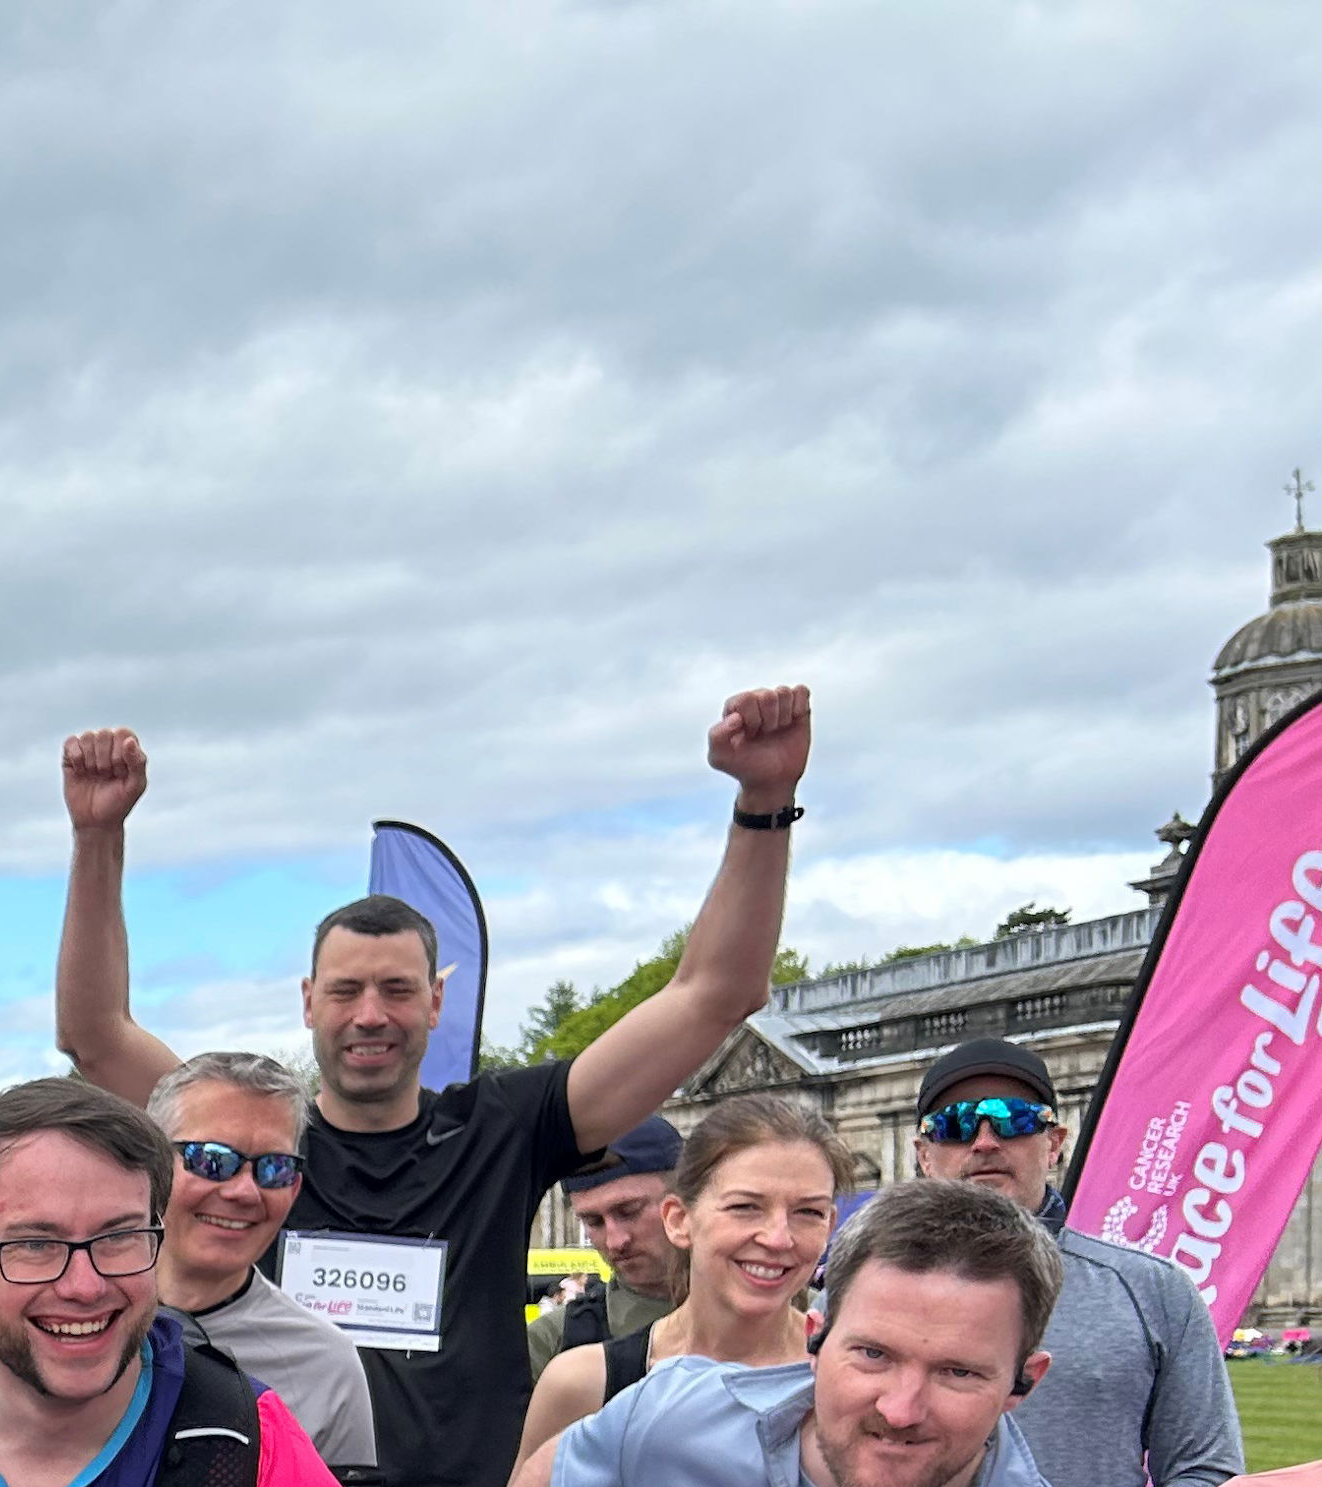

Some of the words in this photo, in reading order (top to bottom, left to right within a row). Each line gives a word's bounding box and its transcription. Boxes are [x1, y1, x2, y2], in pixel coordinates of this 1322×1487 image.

[1129, 1116, 1167, 1190] CANCER
[1147, 1100, 1192, 1195] RESEARCH
[1163, 1172, 1183, 1196] UK
[1170, 1141, 1245, 1304] ace
[1212, 1031, 1282, 1138] for
[312, 1267, 407, 1293] 326096
